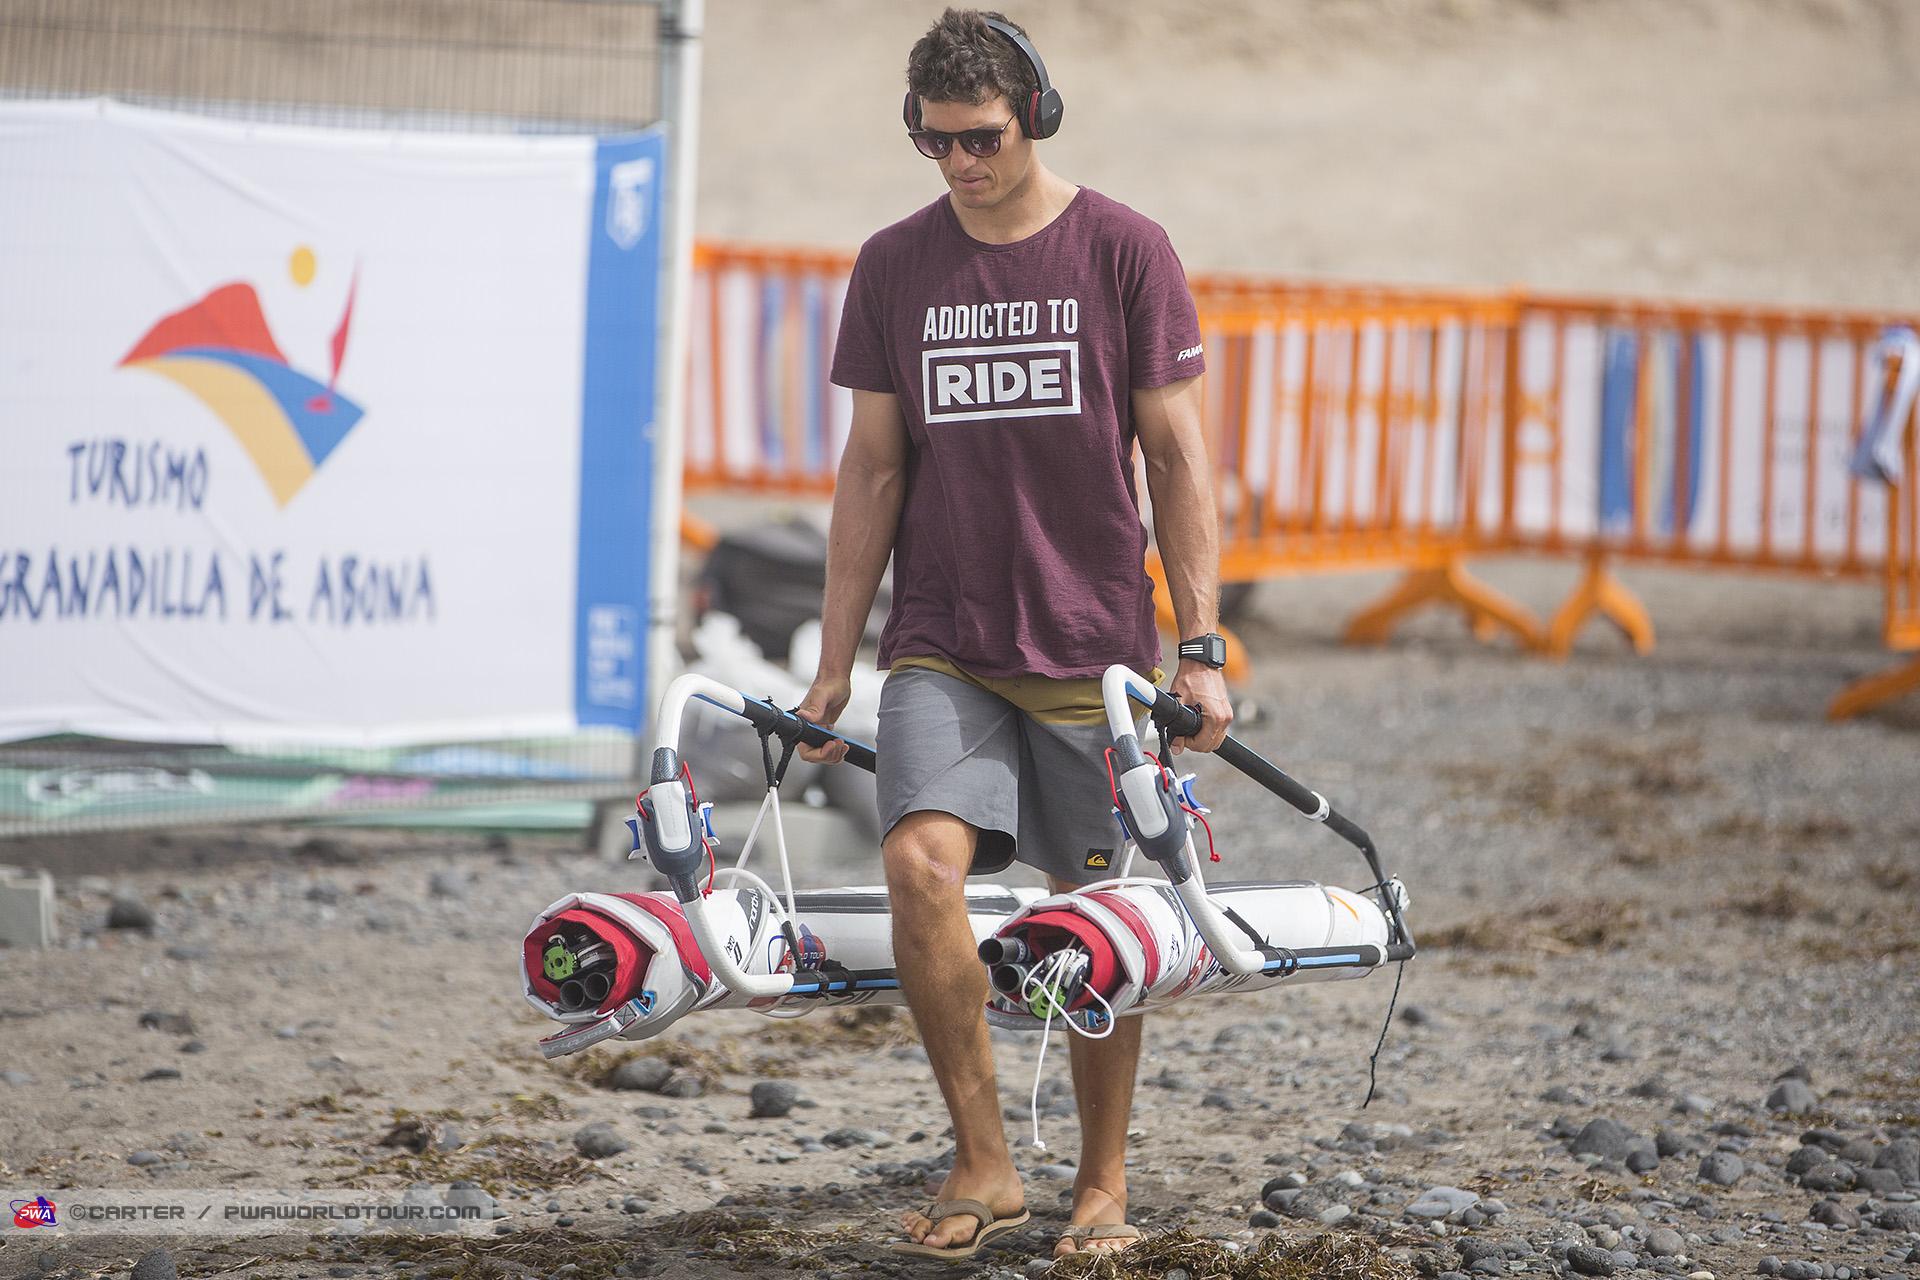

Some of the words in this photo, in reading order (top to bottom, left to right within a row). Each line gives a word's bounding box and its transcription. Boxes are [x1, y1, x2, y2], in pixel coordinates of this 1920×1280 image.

[922, 300, 1038, 341] ADDICTED
[1048, 298, 1079, 334] TO
[936, 358, 1063, 407] RIDE
[68, 438, 209, 512] TURISMO
[249, 550, 293, 623] DE
[308, 551, 437, 627] ABONA
